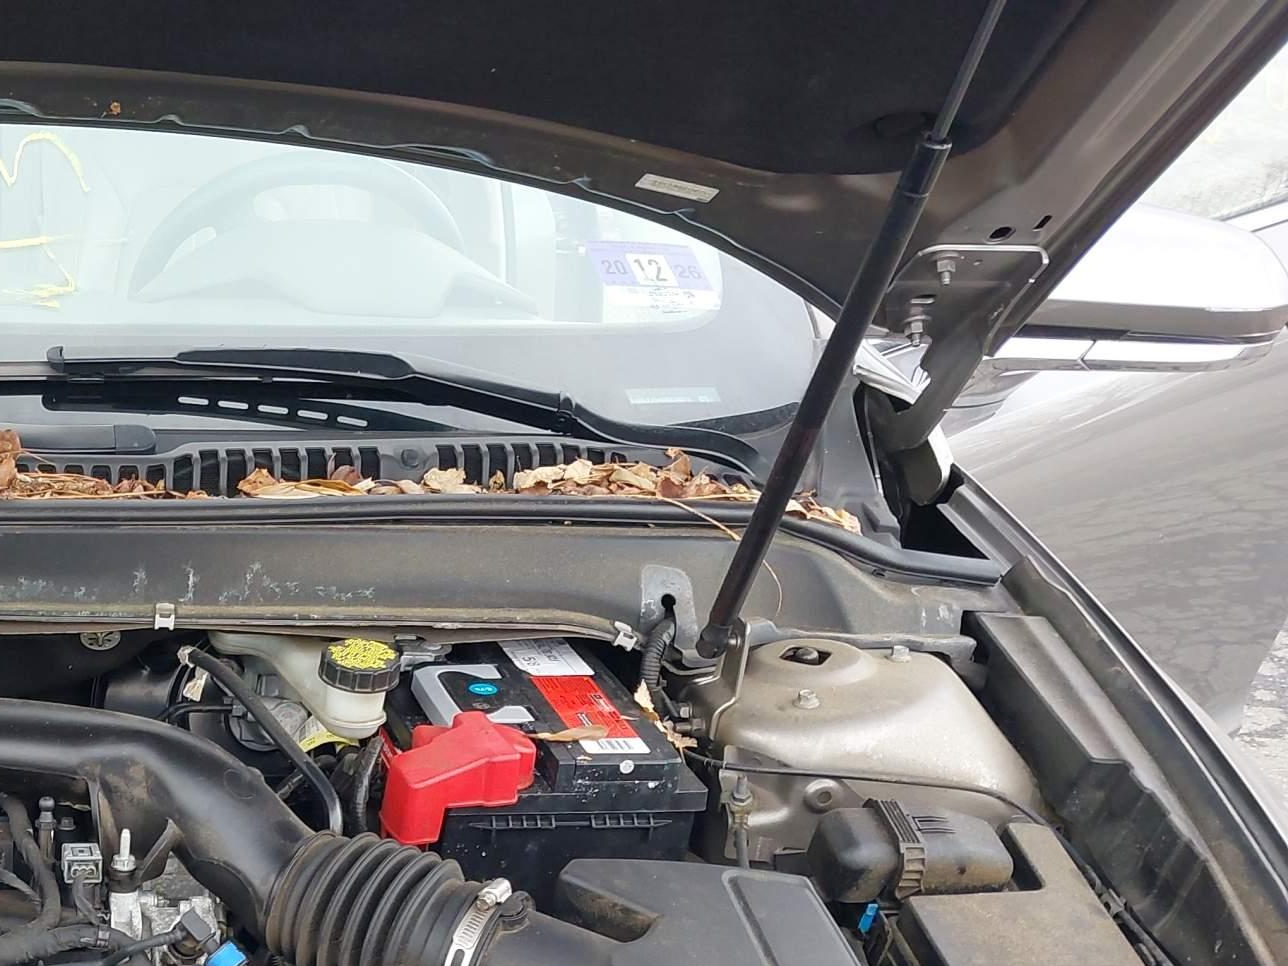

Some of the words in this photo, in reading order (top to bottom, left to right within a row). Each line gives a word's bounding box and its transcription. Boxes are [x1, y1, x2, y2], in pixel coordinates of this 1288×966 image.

[600, 258, 629, 276] 20
[633, 258, 669, 282] 12
[673, 263, 702, 280] 26
